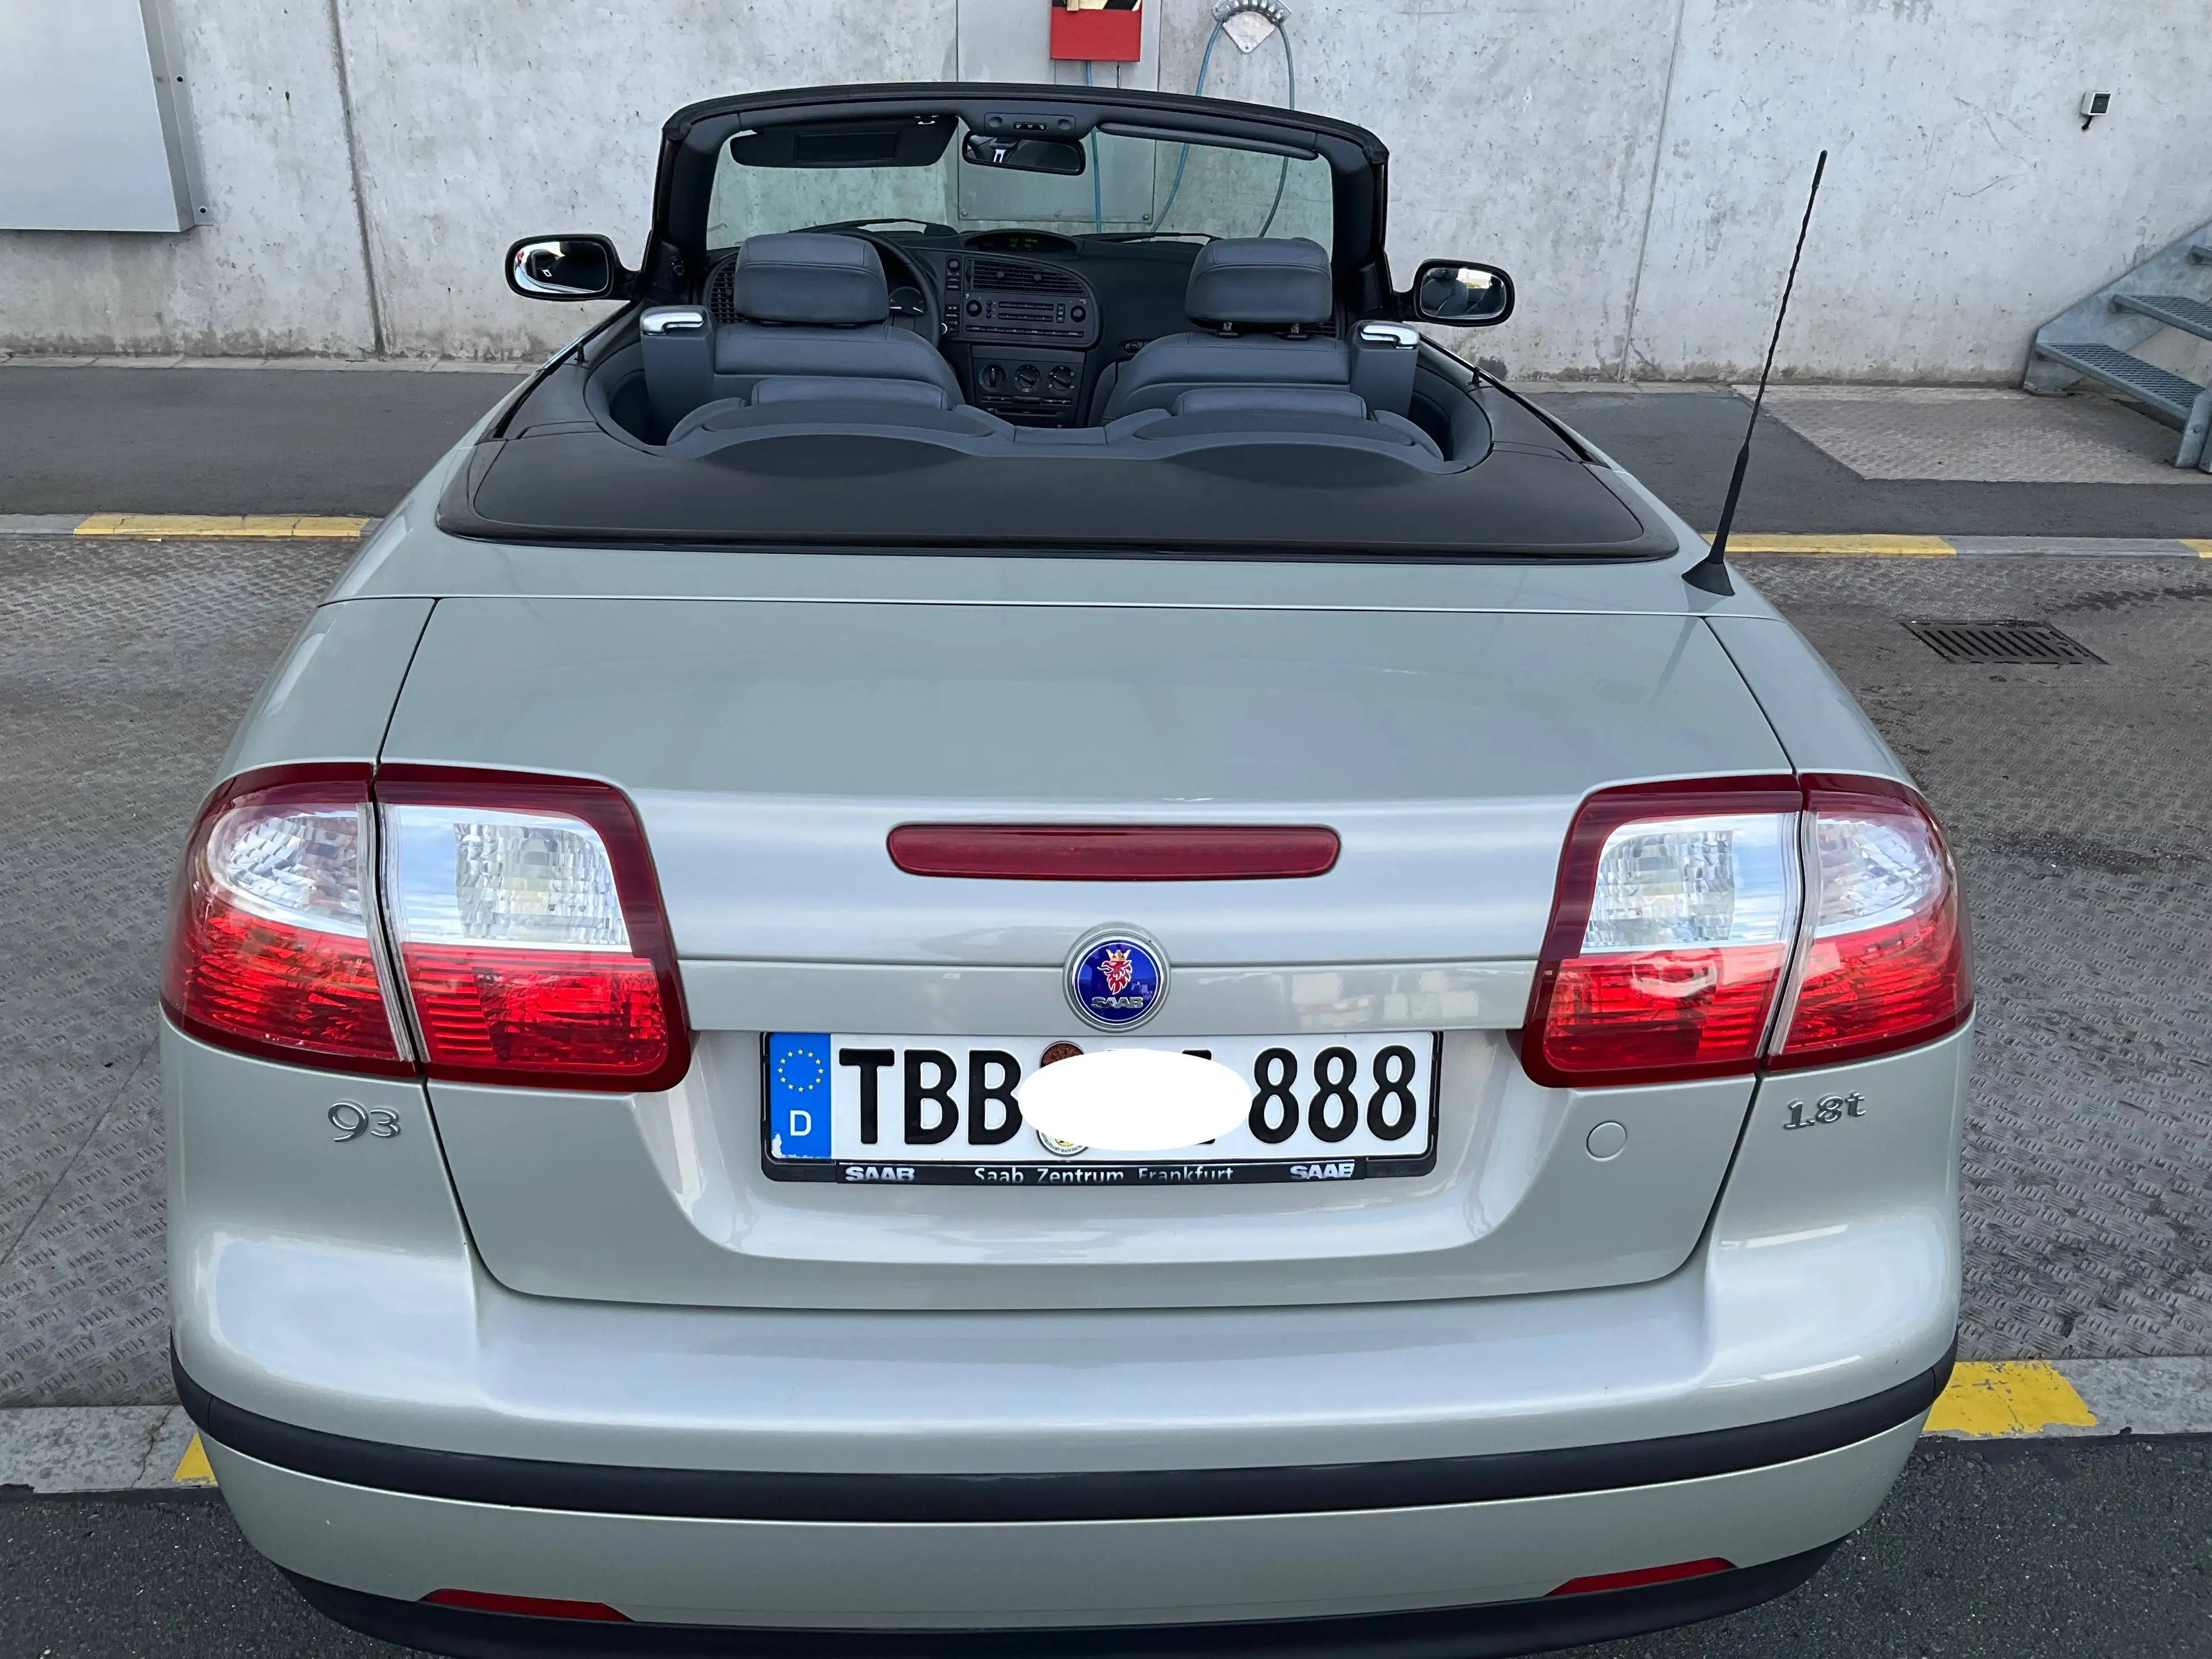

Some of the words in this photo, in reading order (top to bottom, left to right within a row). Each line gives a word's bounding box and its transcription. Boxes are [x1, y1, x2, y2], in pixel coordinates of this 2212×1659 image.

[1091, 997, 1144, 1008] SAAB
[839, 1048, 1023, 1145] TBB
[1248, 1044, 1416, 1143] 888
[328, 1100, 401, 1142] 93
[790, 1110, 812, 1136] D
[1783, 1090, 1866, 1130] 1.8t
[845, 1166, 915, 1181] SAAB
[974, 1166, 1024, 1184] Saab
[1037, 1168, 1124, 1184] Zentrum
[1139, 1165, 1233, 1183] Frankfurt
